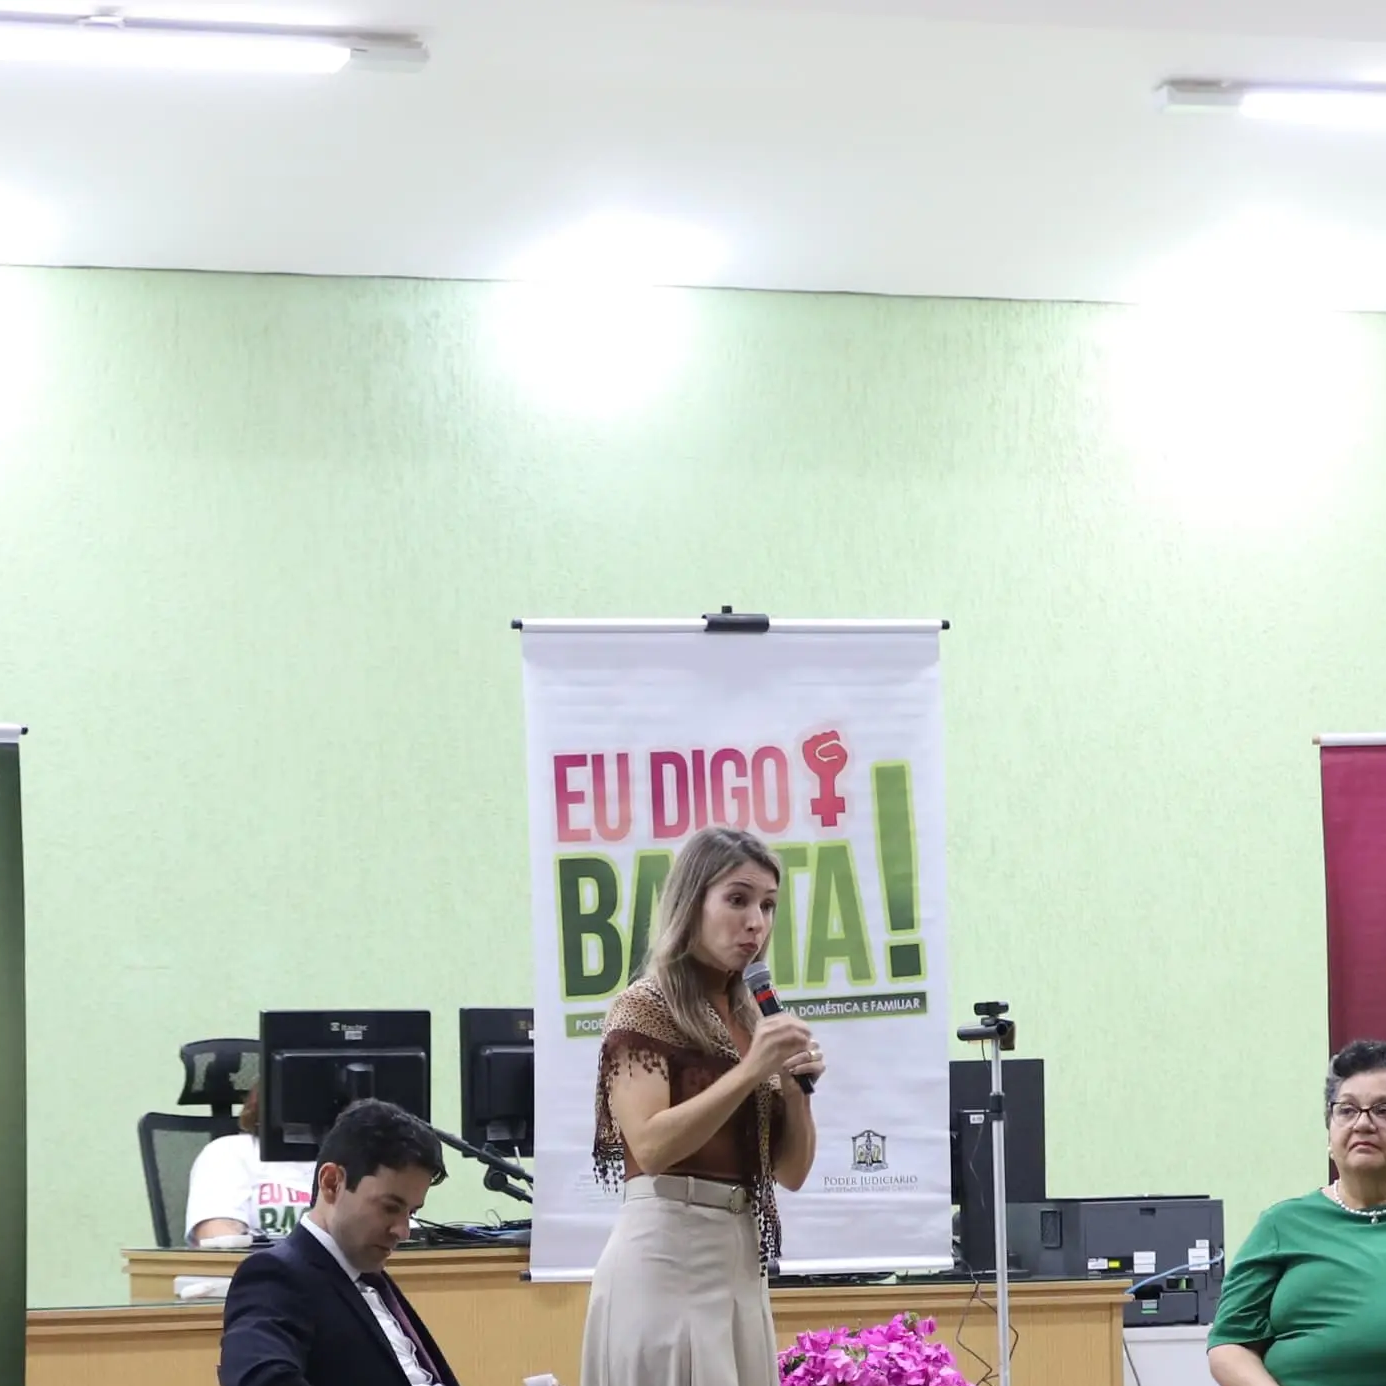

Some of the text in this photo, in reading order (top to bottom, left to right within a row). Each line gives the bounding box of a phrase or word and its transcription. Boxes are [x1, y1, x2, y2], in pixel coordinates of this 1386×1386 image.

[553, 744, 791, 843] EU DIGO
[555, 762, 924, 1001] BATA!
[799, 1001, 860, 1017] DOMÉSTICA
[862, 1002, 869, 1013] E
[870, 998, 921, 1012] FAMILIAR
[575, 1018, 606, 1031] PODE
[823, 1176, 858, 1186] PODER
